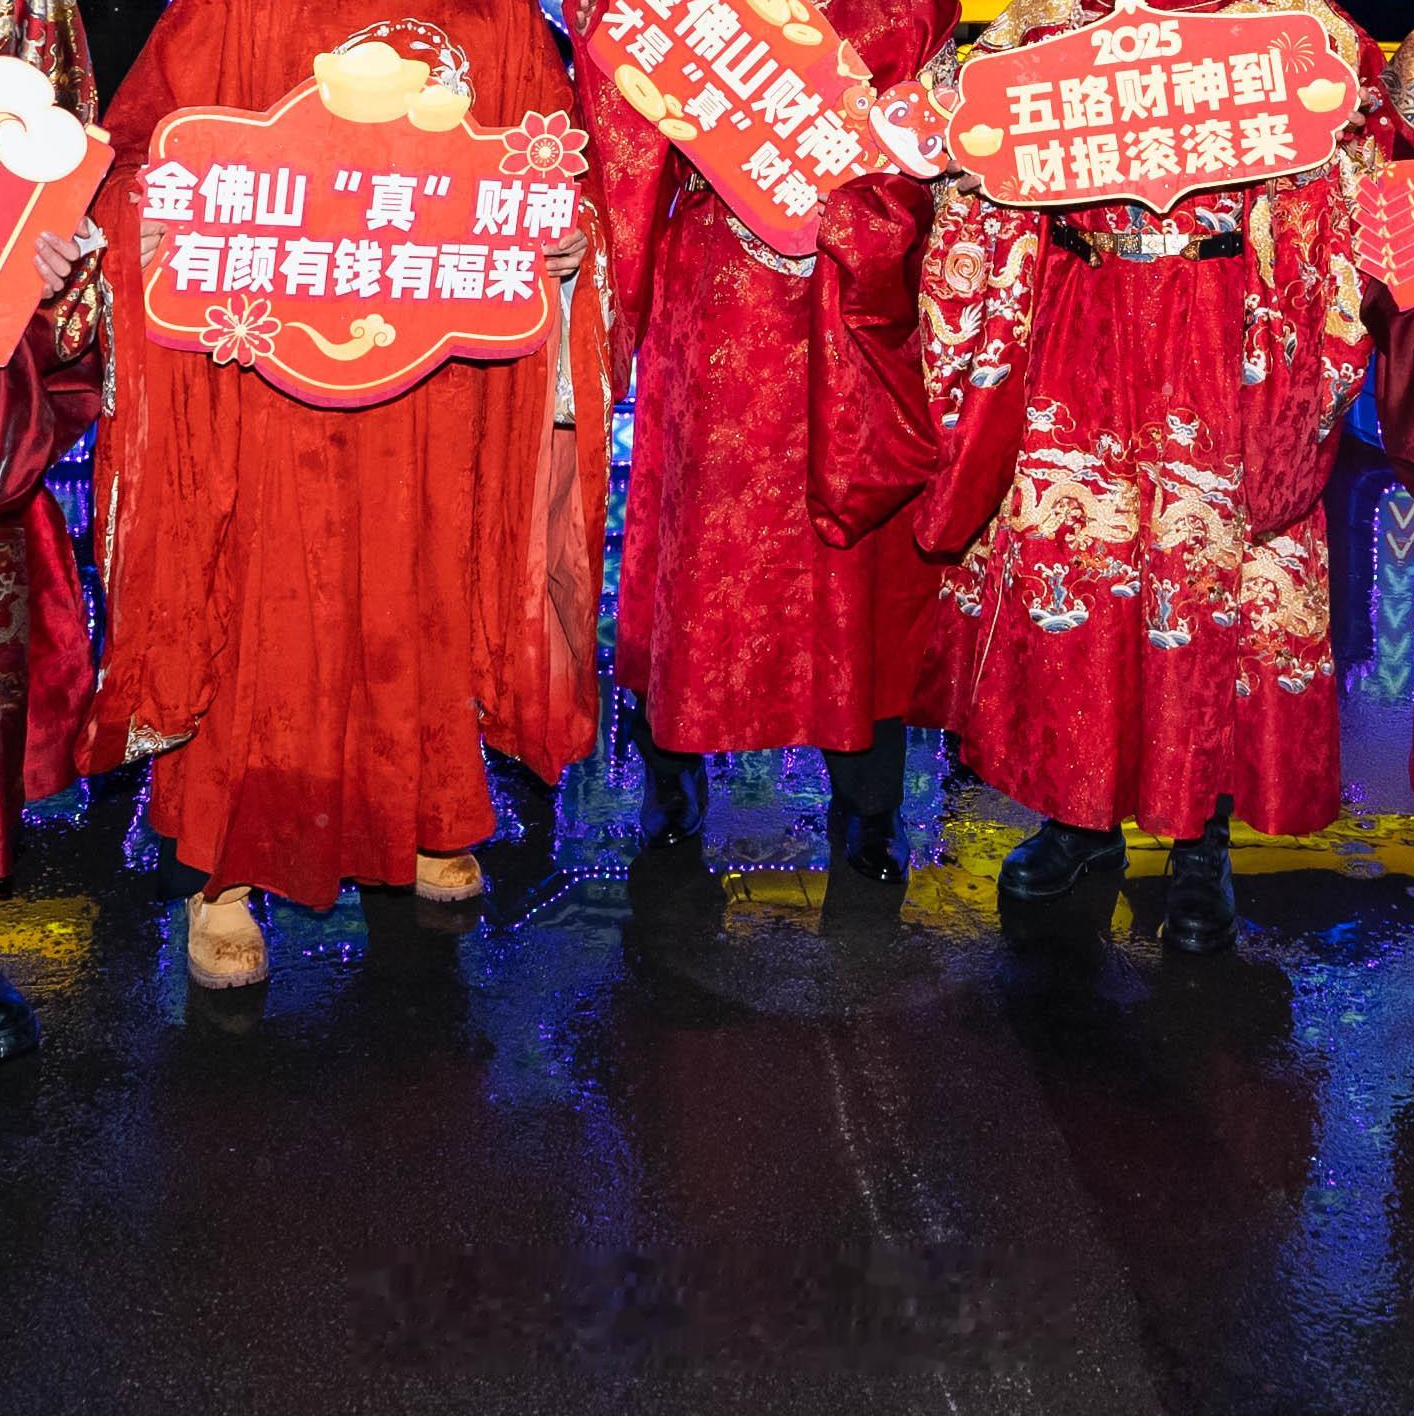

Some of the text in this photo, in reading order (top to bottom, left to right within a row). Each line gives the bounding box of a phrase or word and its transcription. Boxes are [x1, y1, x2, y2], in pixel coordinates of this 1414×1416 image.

[1090, 20, 1182, 66] 2025
[1005, 49, 1288, 136] 五路财神到
[1013, 113, 1298, 195] 财报滚滚来
[168, 231, 537, 302] 有颜有钱有福来
